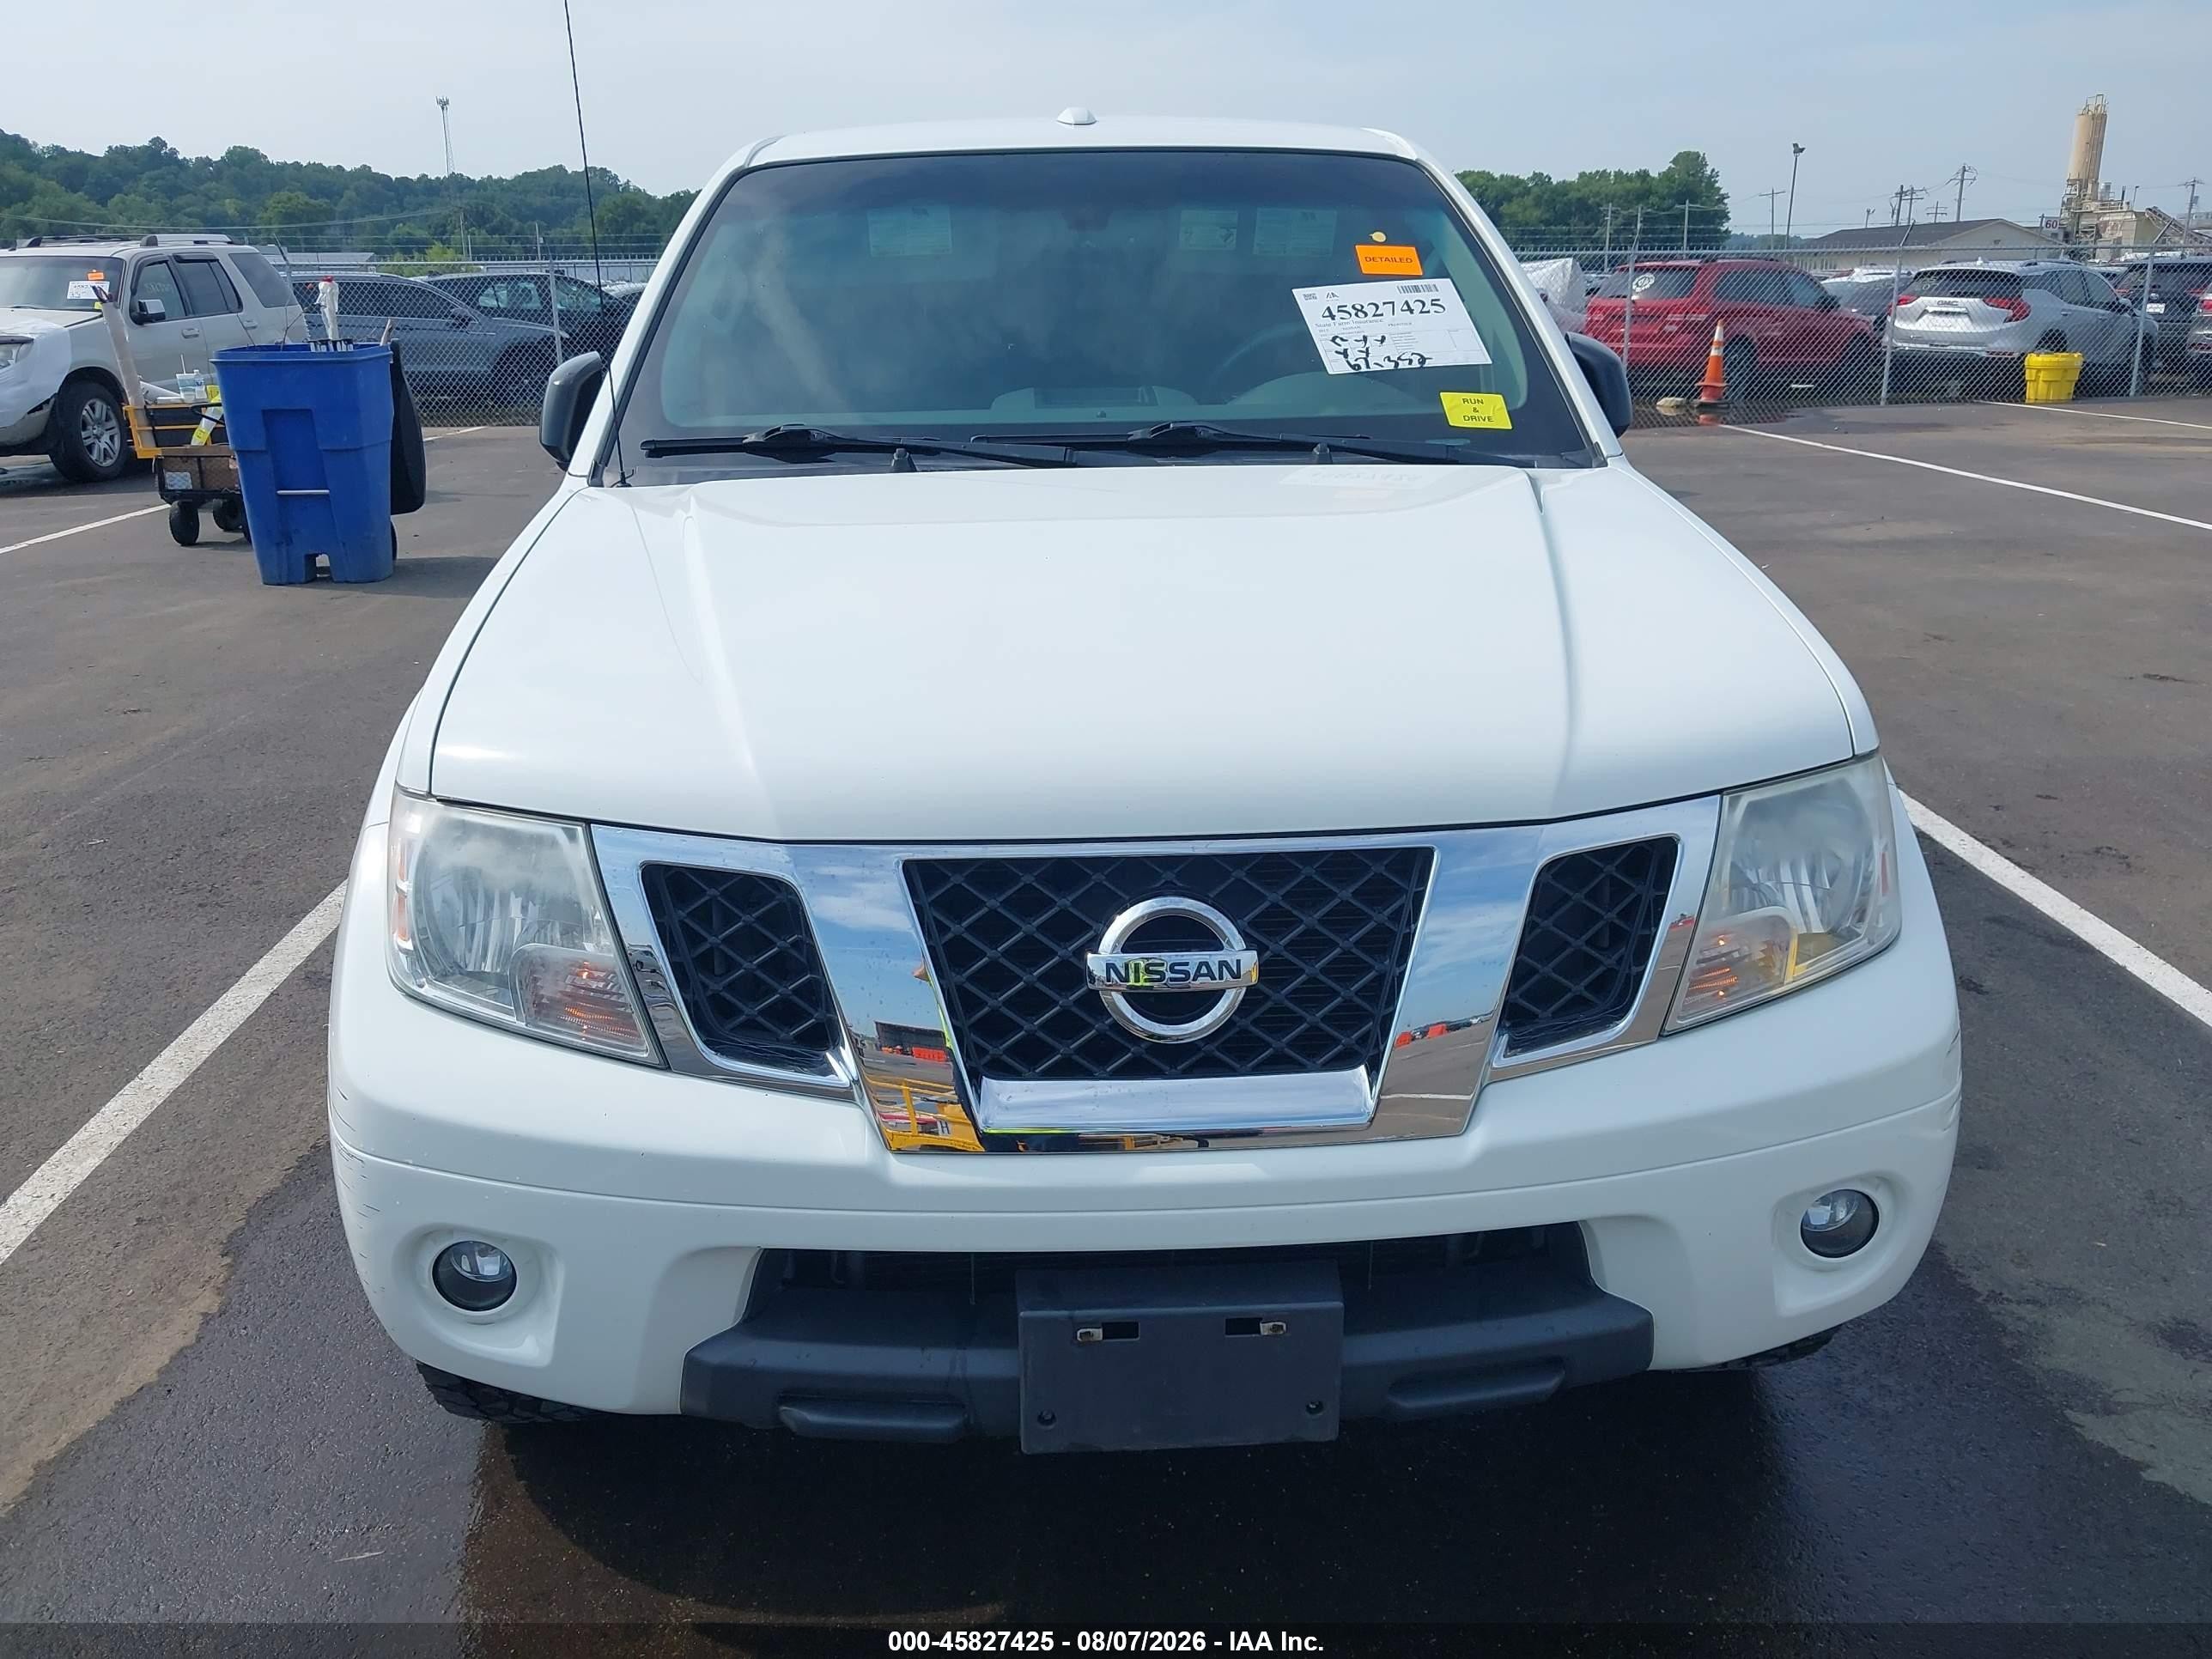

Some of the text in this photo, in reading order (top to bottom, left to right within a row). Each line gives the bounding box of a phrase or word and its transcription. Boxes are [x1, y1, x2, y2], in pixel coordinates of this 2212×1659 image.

[2045, 219, 2058, 229] 60
[1322, 299, 1446, 321] 45827425
[1105, 959, 1242, 983] NISSAN
